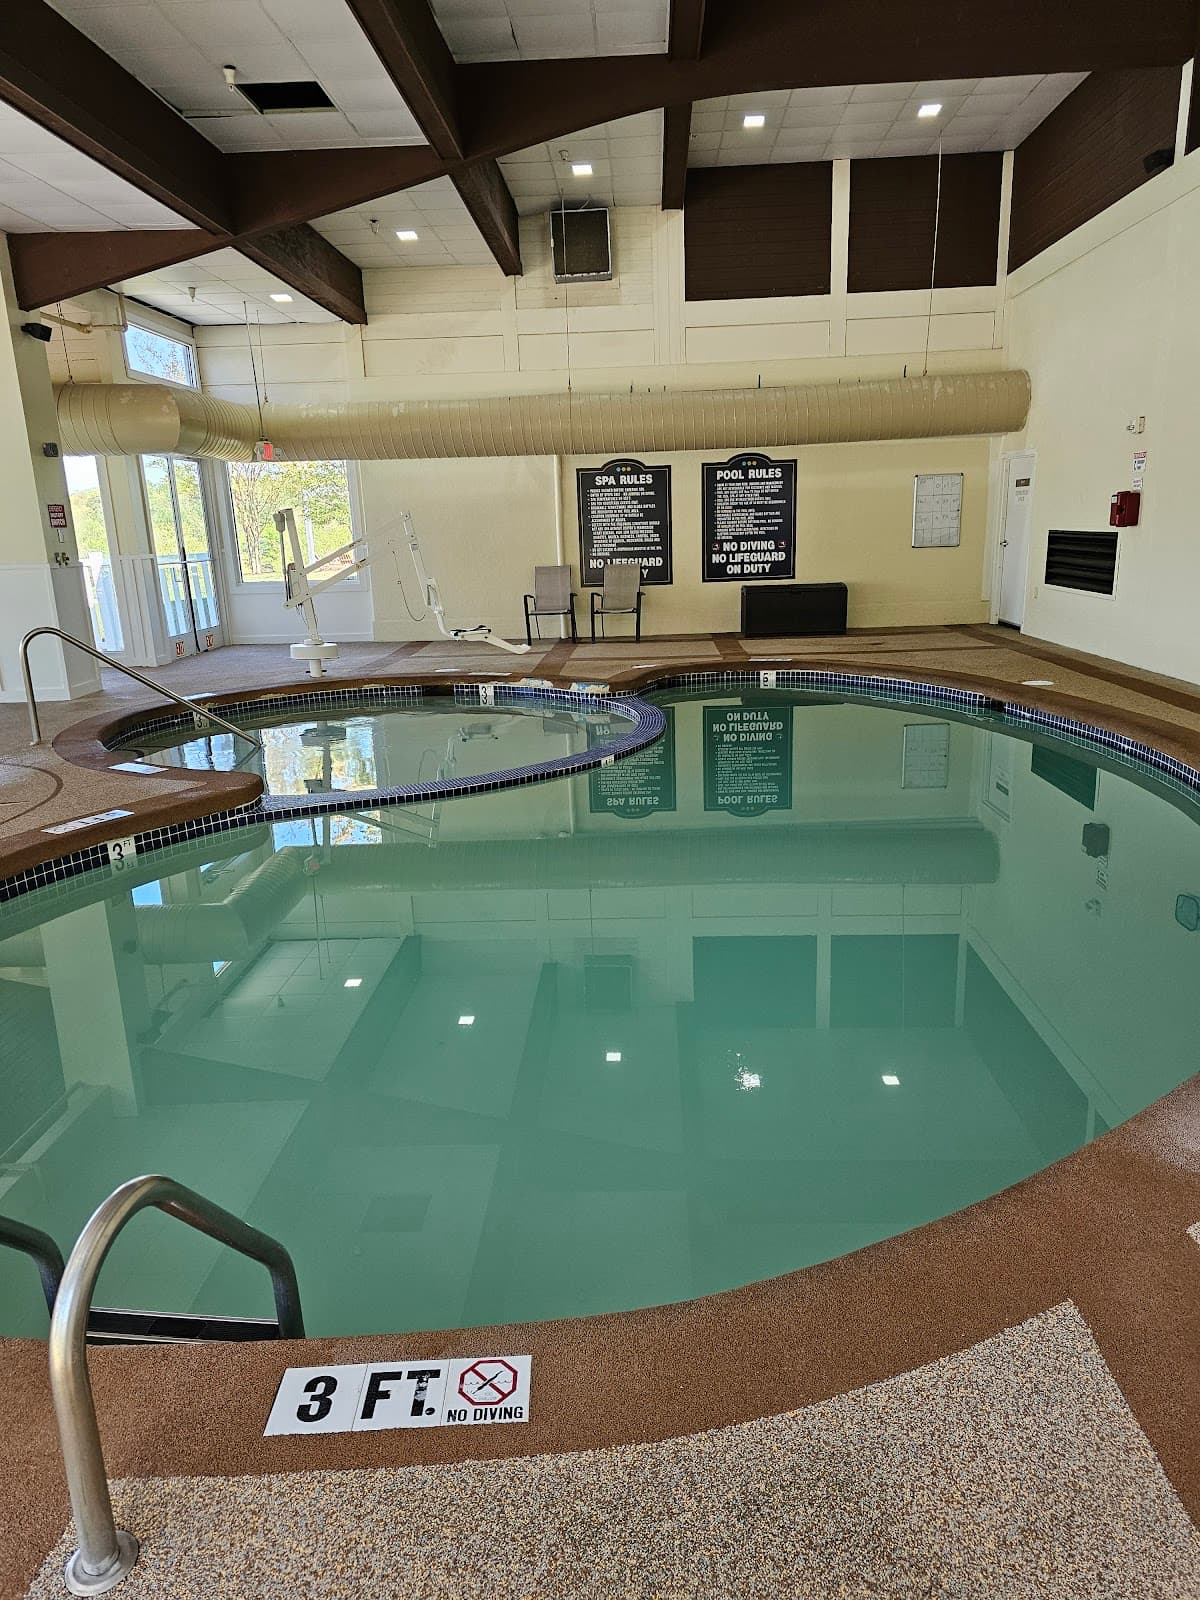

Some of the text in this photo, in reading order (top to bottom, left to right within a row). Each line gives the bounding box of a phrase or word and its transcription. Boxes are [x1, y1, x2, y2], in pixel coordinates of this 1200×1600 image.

[595, 474, 653, 486] SPA RULES
[717, 468, 782, 480] POOL RULES
[723, 540, 775, 551] NO DIVING
[589, 558, 604, 569] NO
[712, 552, 786, 563] NO LIFEGUARD
[727, 563, 771, 574] ON DUTY
[112, 843, 124, 860] 3
[297, 1375, 338, 1422] 3
[447, 1406, 523, 1422] NO DIVING
